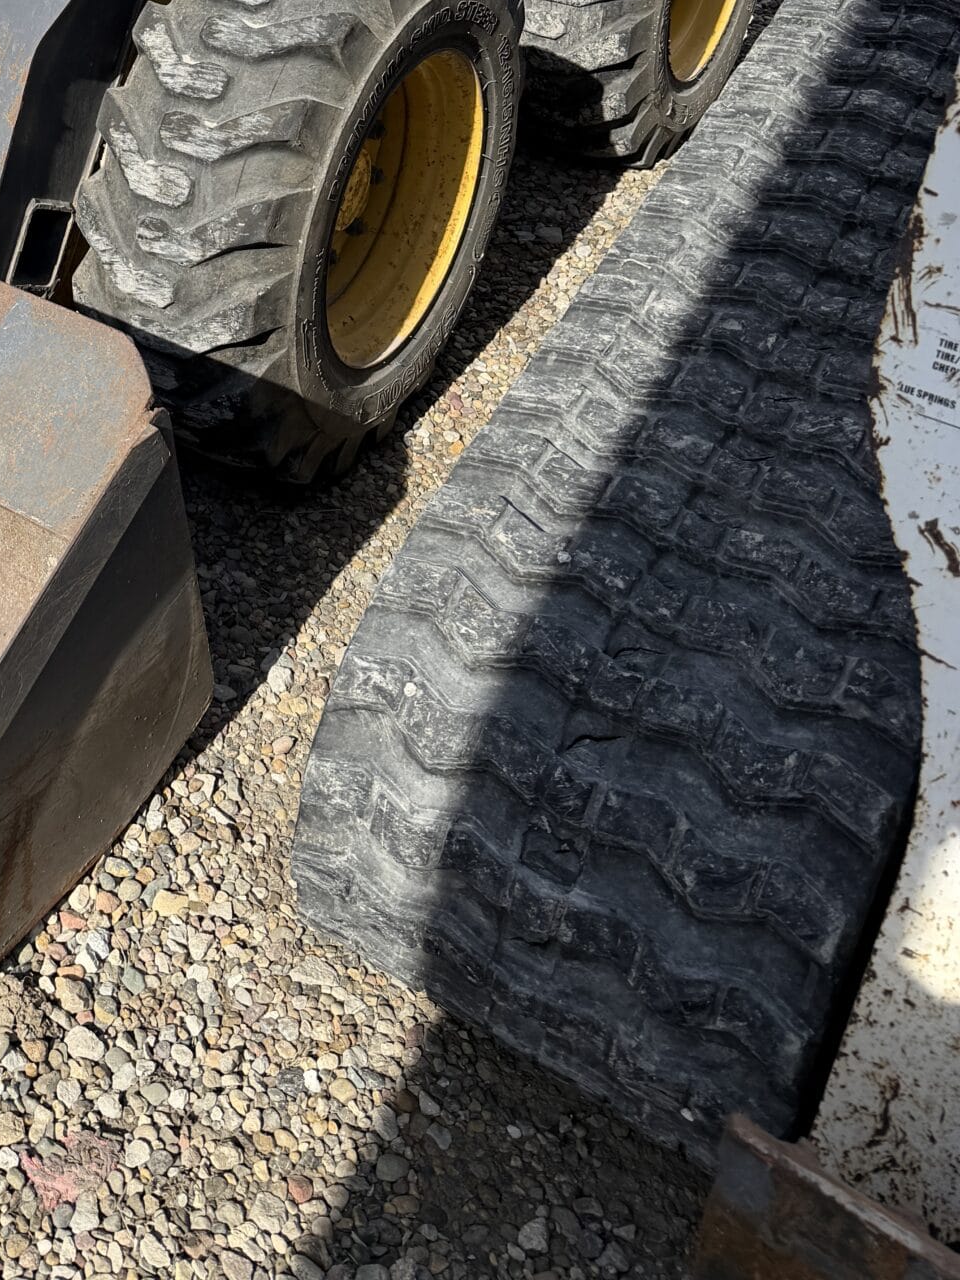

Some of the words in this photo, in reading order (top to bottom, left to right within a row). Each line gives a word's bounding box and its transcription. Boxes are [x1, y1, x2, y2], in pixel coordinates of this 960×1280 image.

[939, 337, 959, 352] TIRE
[932, 361, 960, 377] CHEC
[897, 381, 916, 397] LUE
[916, 389, 957, 409] SPRINGS
